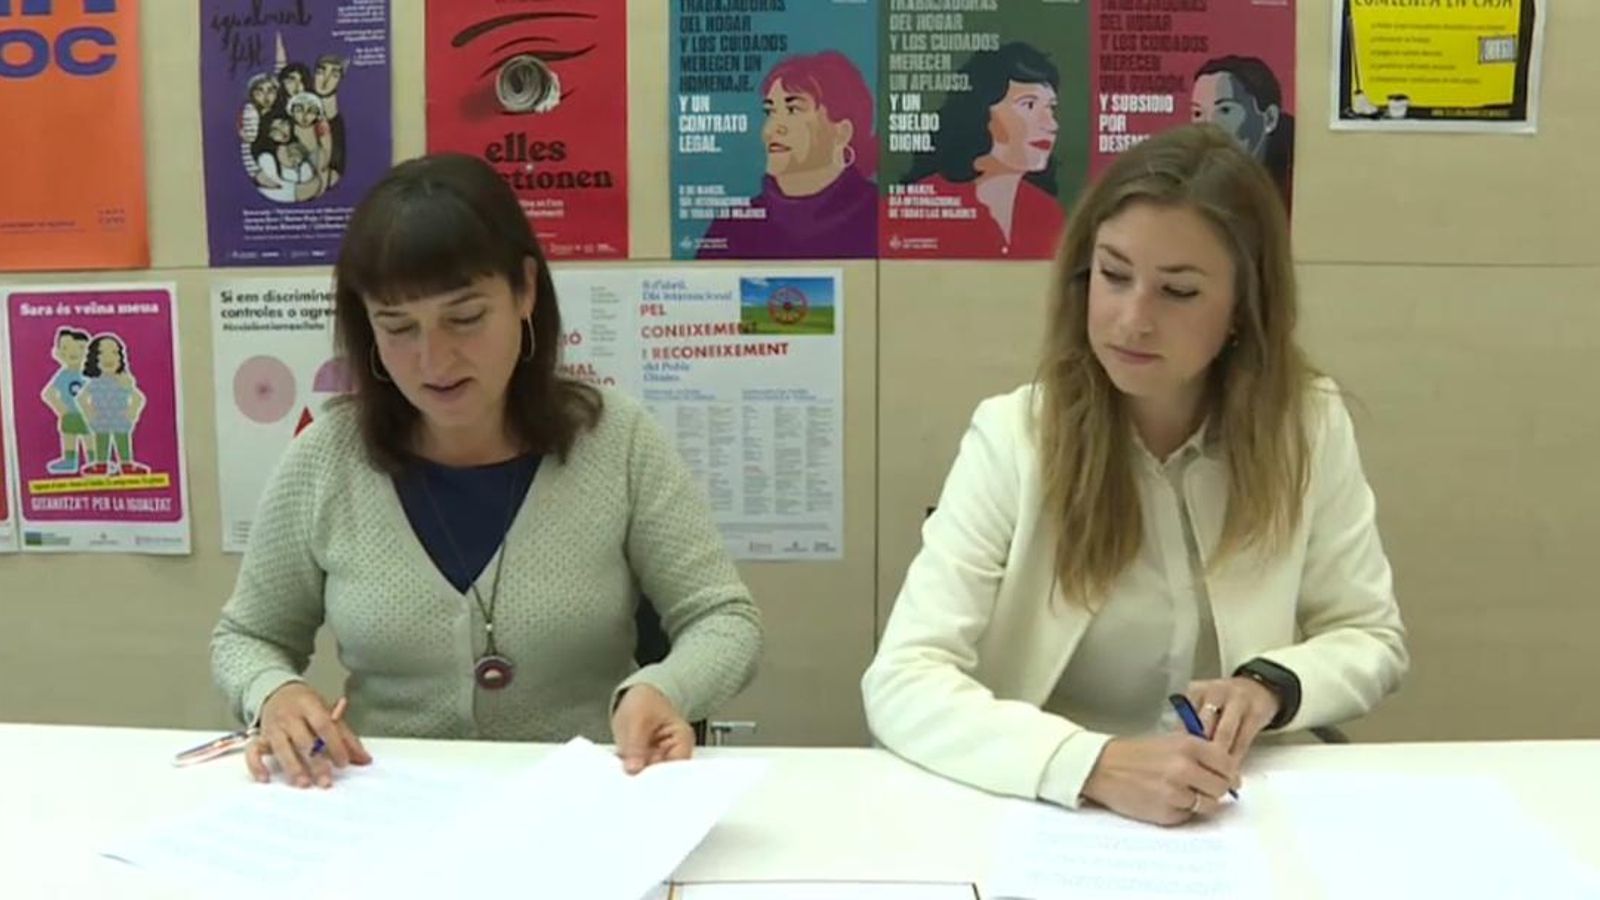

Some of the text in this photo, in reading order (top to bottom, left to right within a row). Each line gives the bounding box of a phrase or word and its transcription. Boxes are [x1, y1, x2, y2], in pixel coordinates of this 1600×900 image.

[679, 15, 751, 33] DEL HOGAR
[890, 14, 963, 31] DEL HOGAR
[679, 35, 788, 52] Y LOS CUIDADOS
[890, 34, 1000, 51] Y LOS CUIDADOS
[1100, 35, 1109, 51] Y
[1112, 35, 1136, 51] LOS
[680, 55, 761, 72] MERECEN UN
[890, 54, 951, 71] MERECEN
[679, 75, 753, 92] HOMENAJE.
[890, 74, 973, 91] UN APLAUSO.
[679, 95, 710, 112] Y UN
[890, 94, 921, 111] Y UN
[1100, 94, 1173, 113] Y SUBSIDIO
[679, 115, 747, 132] CONTRATO
[889, 114, 939, 131] SUELDO
[1099, 114, 1127, 132] POR
[485, 132, 566, 162] elles
[679, 135, 721, 152] LEGAL.
[889, 134, 936, 152] DIGNO.
[221, 289, 233, 303] Si
[236, 294, 259, 303] em
[20, 303, 53, 316] Sara
[118, 303, 159, 314] meua
[220, 306, 283, 318] controles
[287, 309, 297, 318] o
[640, 304, 667, 316] PEL
[641, 323, 758, 339] CONEIXEMENT
[642, 342, 789, 360] I RECONEIXEMENT
